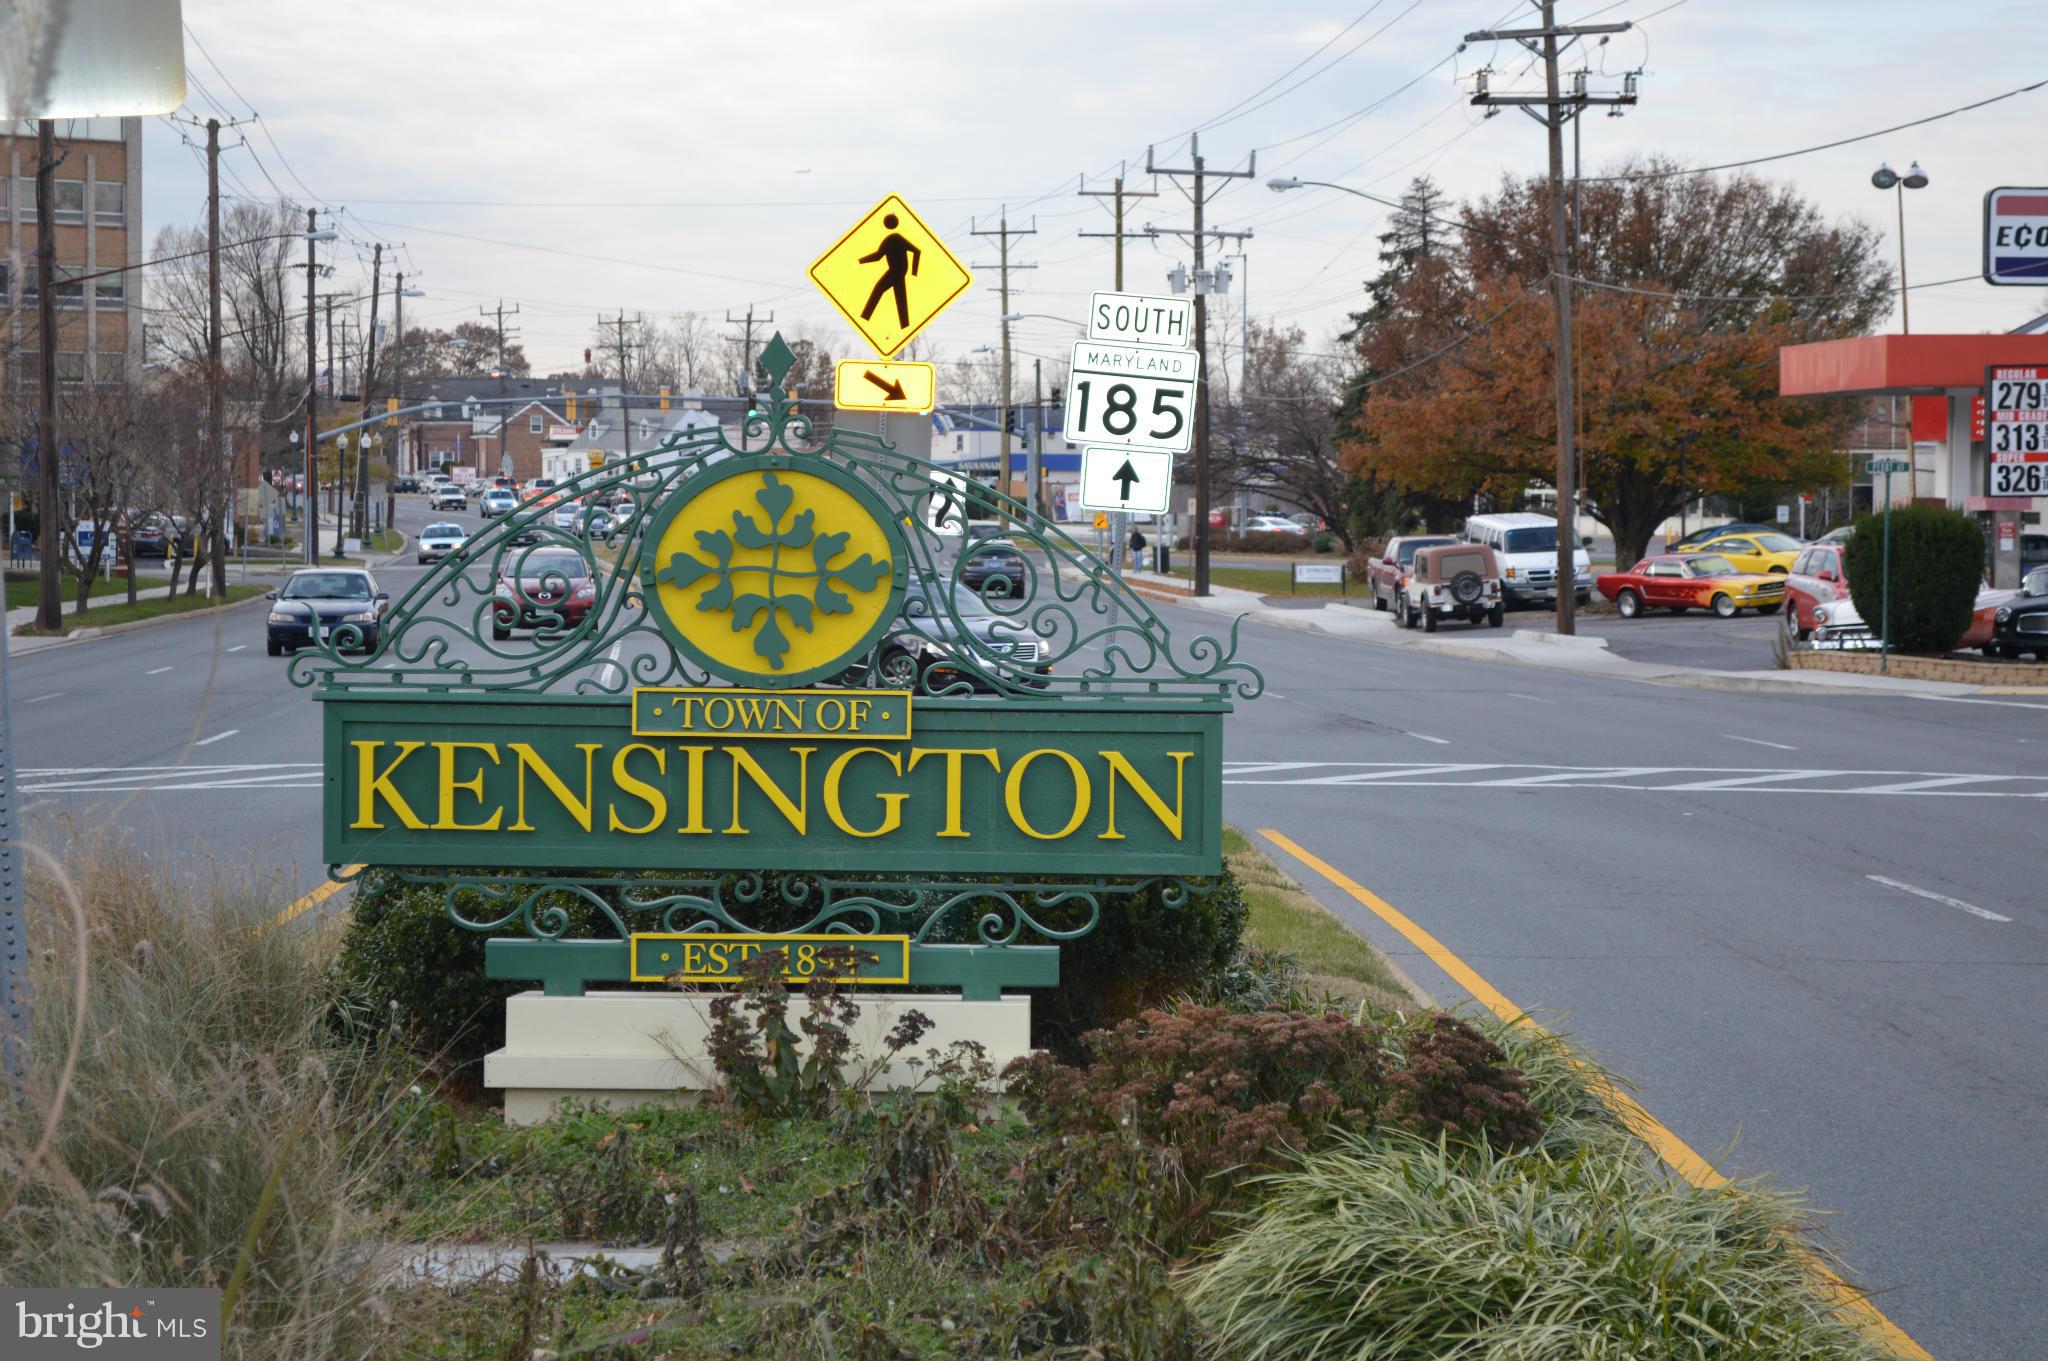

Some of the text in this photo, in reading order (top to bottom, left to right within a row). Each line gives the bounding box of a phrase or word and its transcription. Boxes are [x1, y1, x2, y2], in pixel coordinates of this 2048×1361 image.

[1097, 303, 1184, 336] SOUTH
[1087, 351, 1182, 373] MARYLAND
[1996, 369, 2037, 380] REGULAR
[1998, 382, 2041, 409] 279
[1077, 380, 1185, 440] 185
[1996, 424, 2039, 451] 313
[1996, 453, 2025, 463] SUPER
[1997, 465, 2040, 492] 326
[672, 697, 873, 731] TOWN OF
[350, 741, 1193, 841] KENSINGTON
